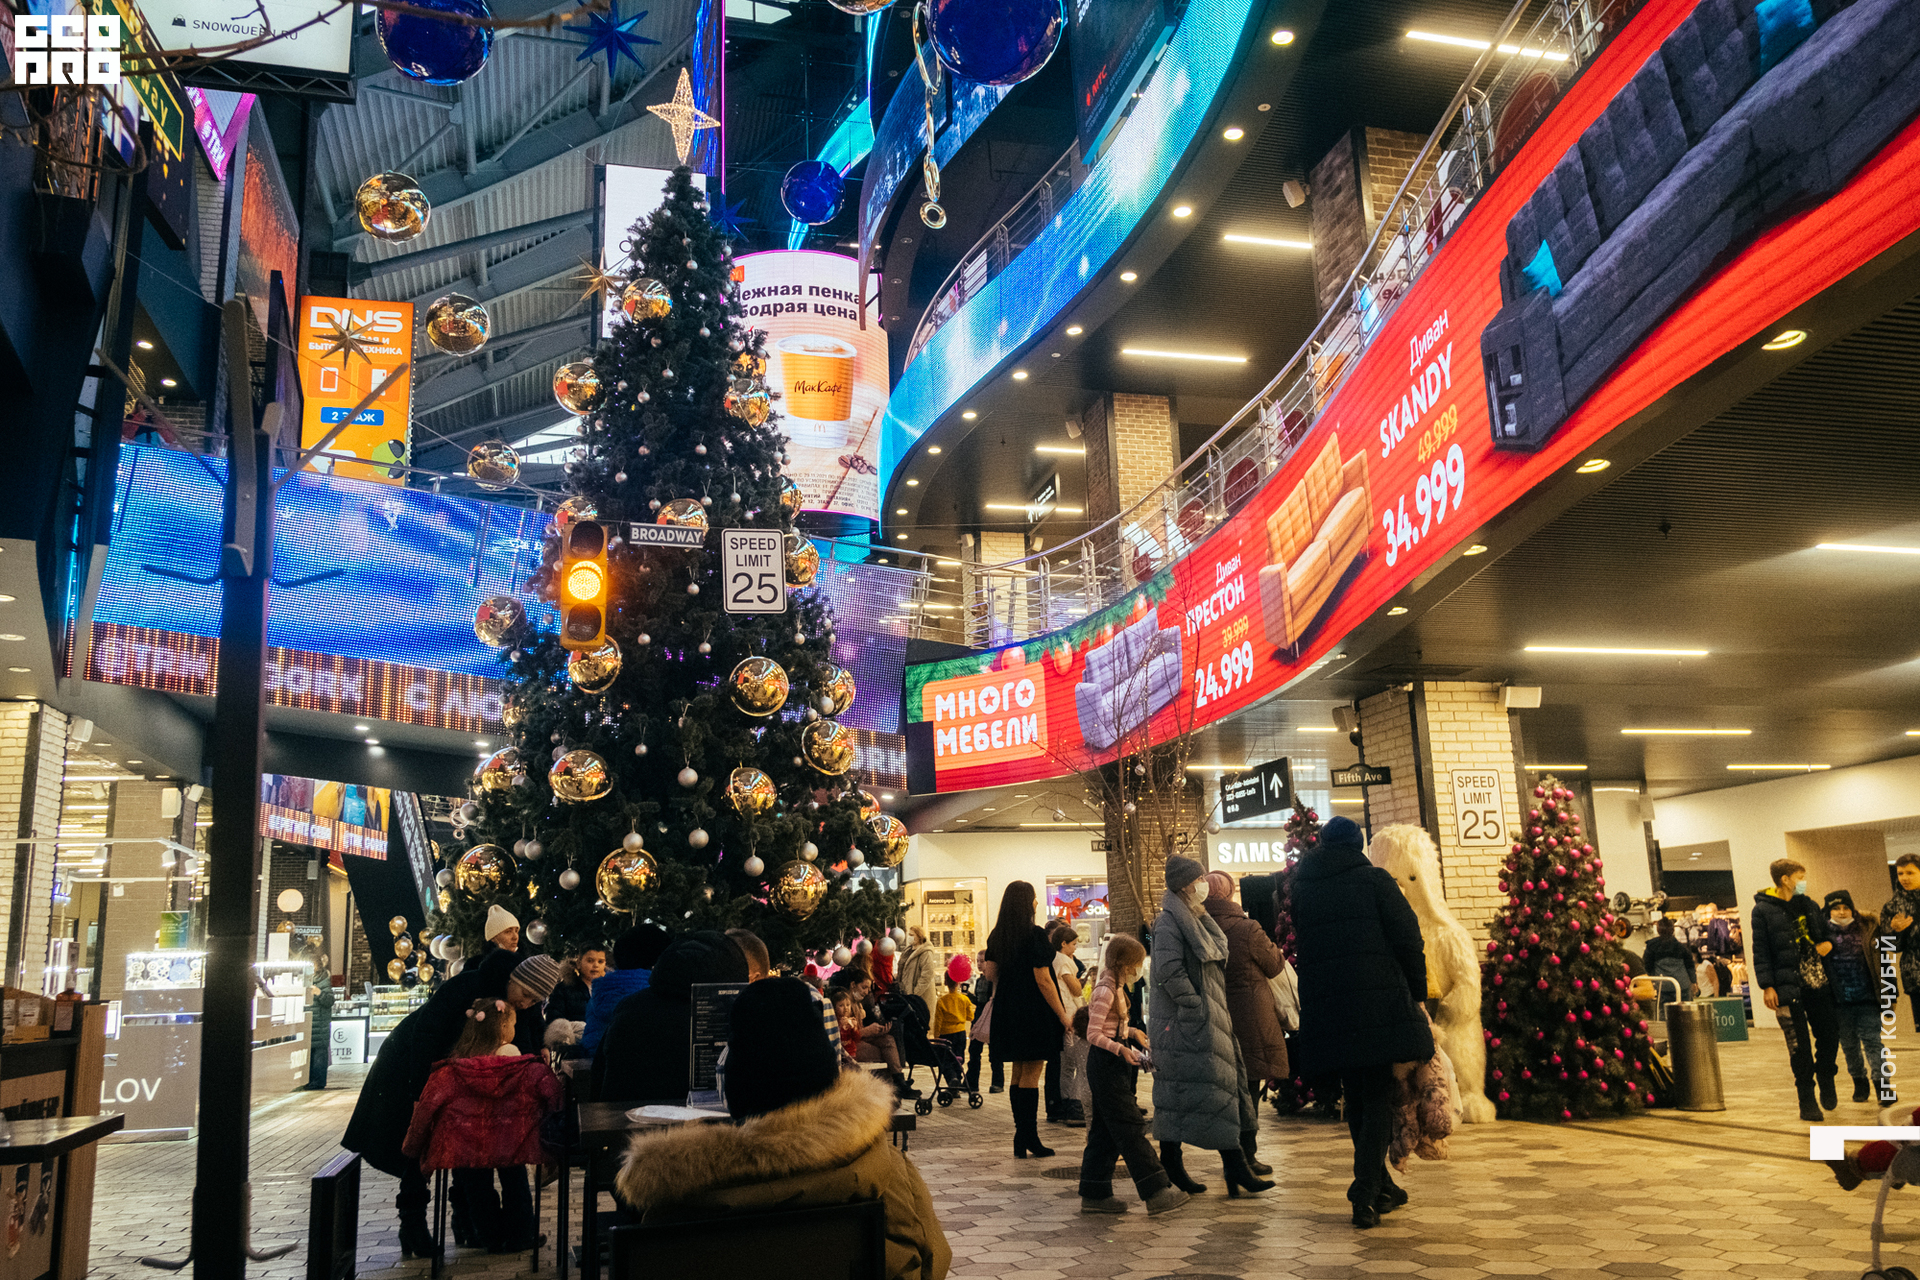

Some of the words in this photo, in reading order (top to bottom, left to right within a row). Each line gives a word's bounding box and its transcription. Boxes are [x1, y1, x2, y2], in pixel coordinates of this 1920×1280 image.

[309, 306, 404, 333] DNS
[813, 302, 858, 321] цена
[1409, 309, 1449, 376] Диван
[1380, 341, 1453, 459] SKANDY
[331, 412, 339, 421] 2
[1417, 403, 1459, 465] 49.999
[1382, 443, 1465, 567] 34.999
[631, 527, 702, 544] BROADWAY
[730, 537, 777, 550] SPEED
[735, 554, 772, 567] LIMIT
[1216, 553, 1242, 588] Диван
[732, 572, 779, 604] 25
[1185, 573, 1246, 637] ПРЕСТОН
[1221, 614, 1249, 649] 39.999
[1195, 640, 1254, 708] 24.999
[934, 678, 1036, 722] МНОГО
[936, 713, 1038, 757] МЕБЕЛИ
[1338, 773, 1361, 783] Fifth
[1364, 772, 1382, 782] Ave
[1457, 776, 1495, 788] SPEED
[1463, 792, 1492, 804] LIMIT
[1462, 810, 1500, 840] 25
